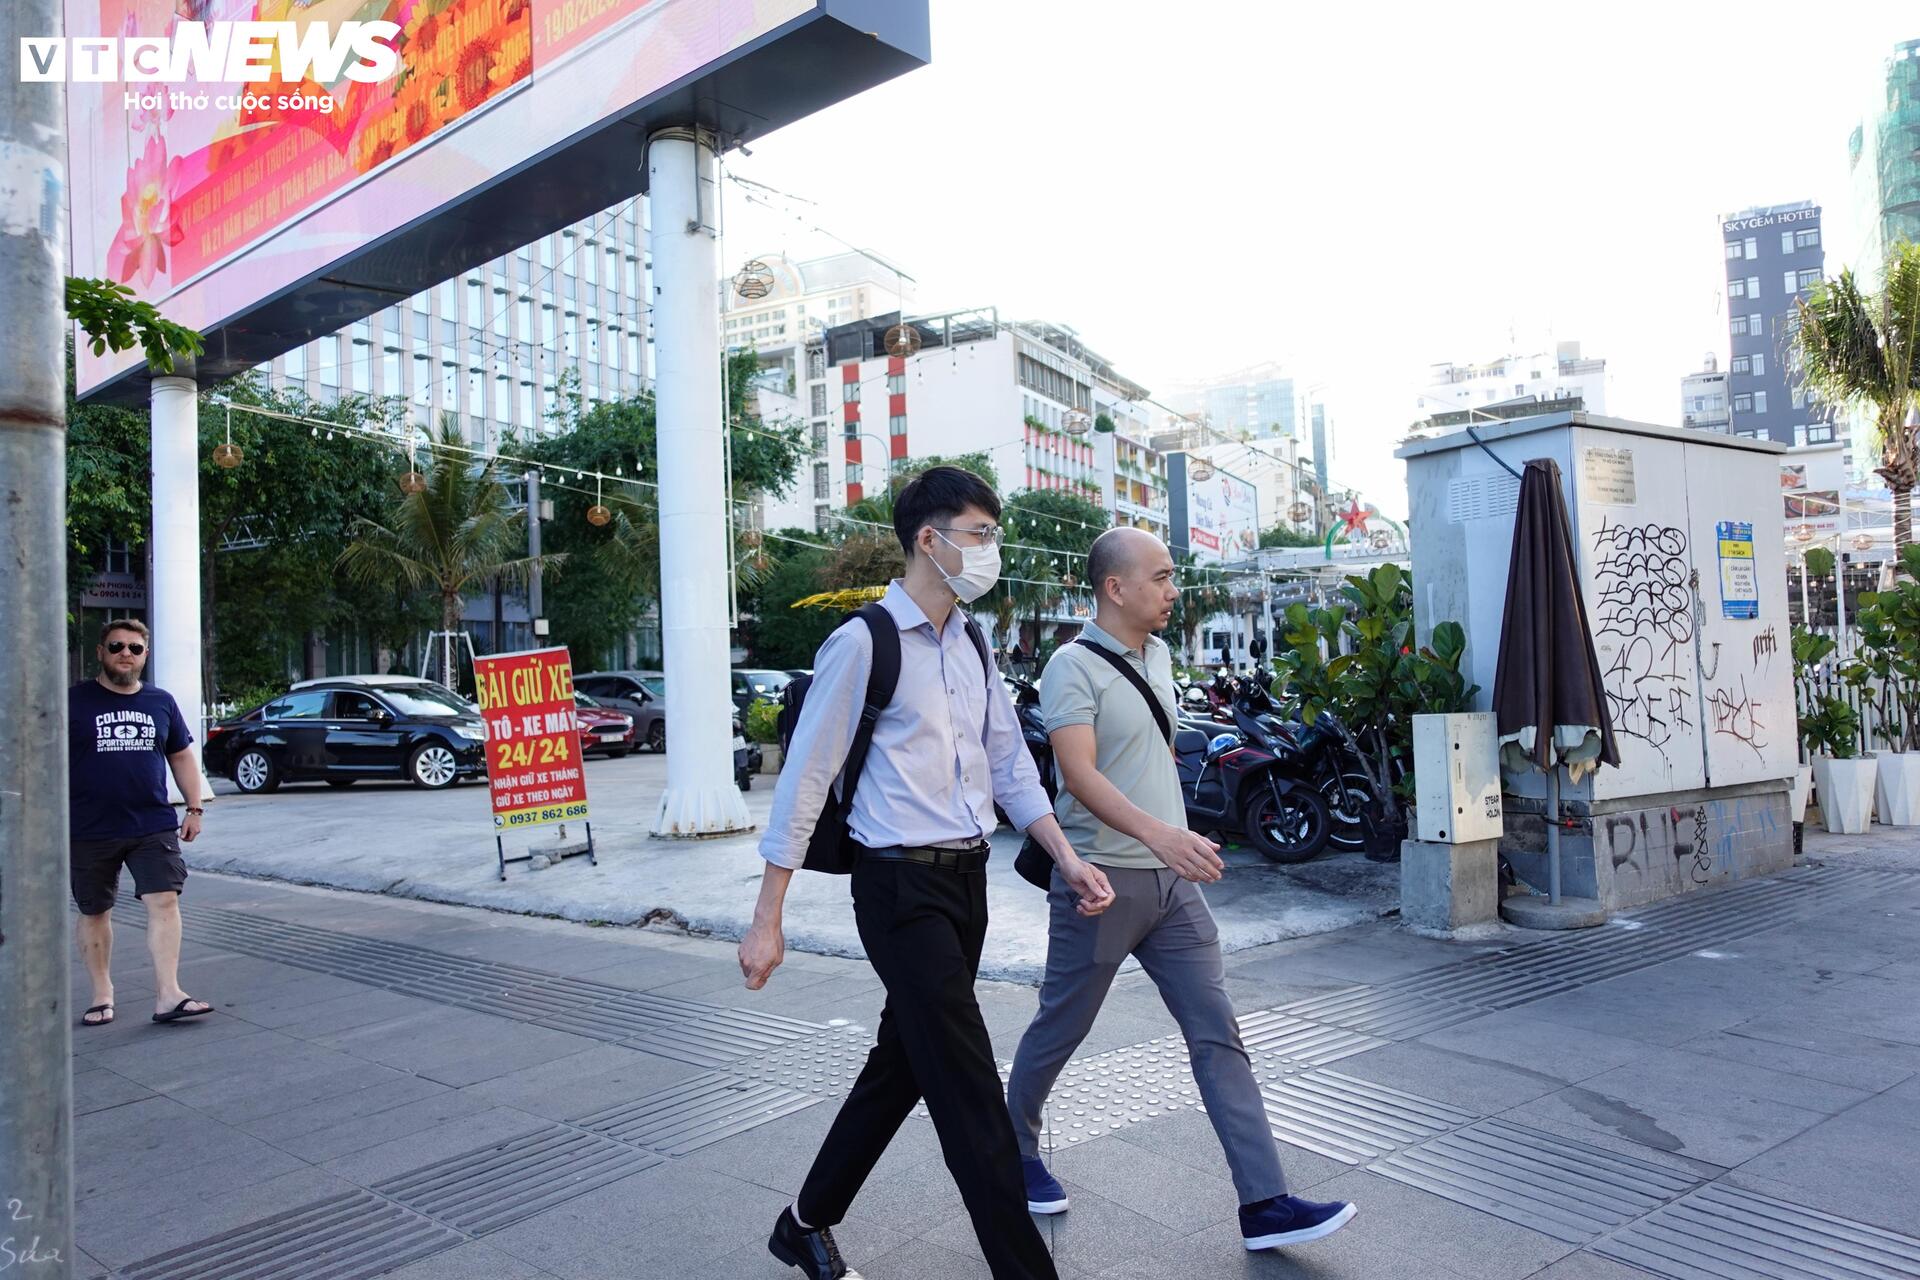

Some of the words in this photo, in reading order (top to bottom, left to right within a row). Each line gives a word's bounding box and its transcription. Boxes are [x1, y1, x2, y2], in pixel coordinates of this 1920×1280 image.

[1725, 215, 1774, 232] SKYGEM
[1777, 208, 1819, 224] HOTEL
[476, 661, 508, 711] BÃI
[511, 657, 544, 707] GIỮ
[547, 663, 574, 702] XE
[95, 710, 156, 727] COLUMBIA
[492, 714, 513, 741] TÔ
[522, 714, 543, 737] XE
[545, 707, 578, 733] MÁY
[97, 726, 112, 739] 19
[141, 726, 156, 738] 38
[97, 739, 144, 748] SPORTSWEAR
[145, 739, 156, 747] CO.
[494, 775, 518, 791] NHẬN
[537, 772, 549, 785] XE
[550, 767, 580, 783] THÁNG
[513, 793, 525, 806] XE
[526, 790, 550, 804] THEO
[551, 785, 574, 801] NGÀY
[510, 811, 538, 825] 0937
[542, 808, 564, 821] 862
[566, 804, 588, 817] 686
